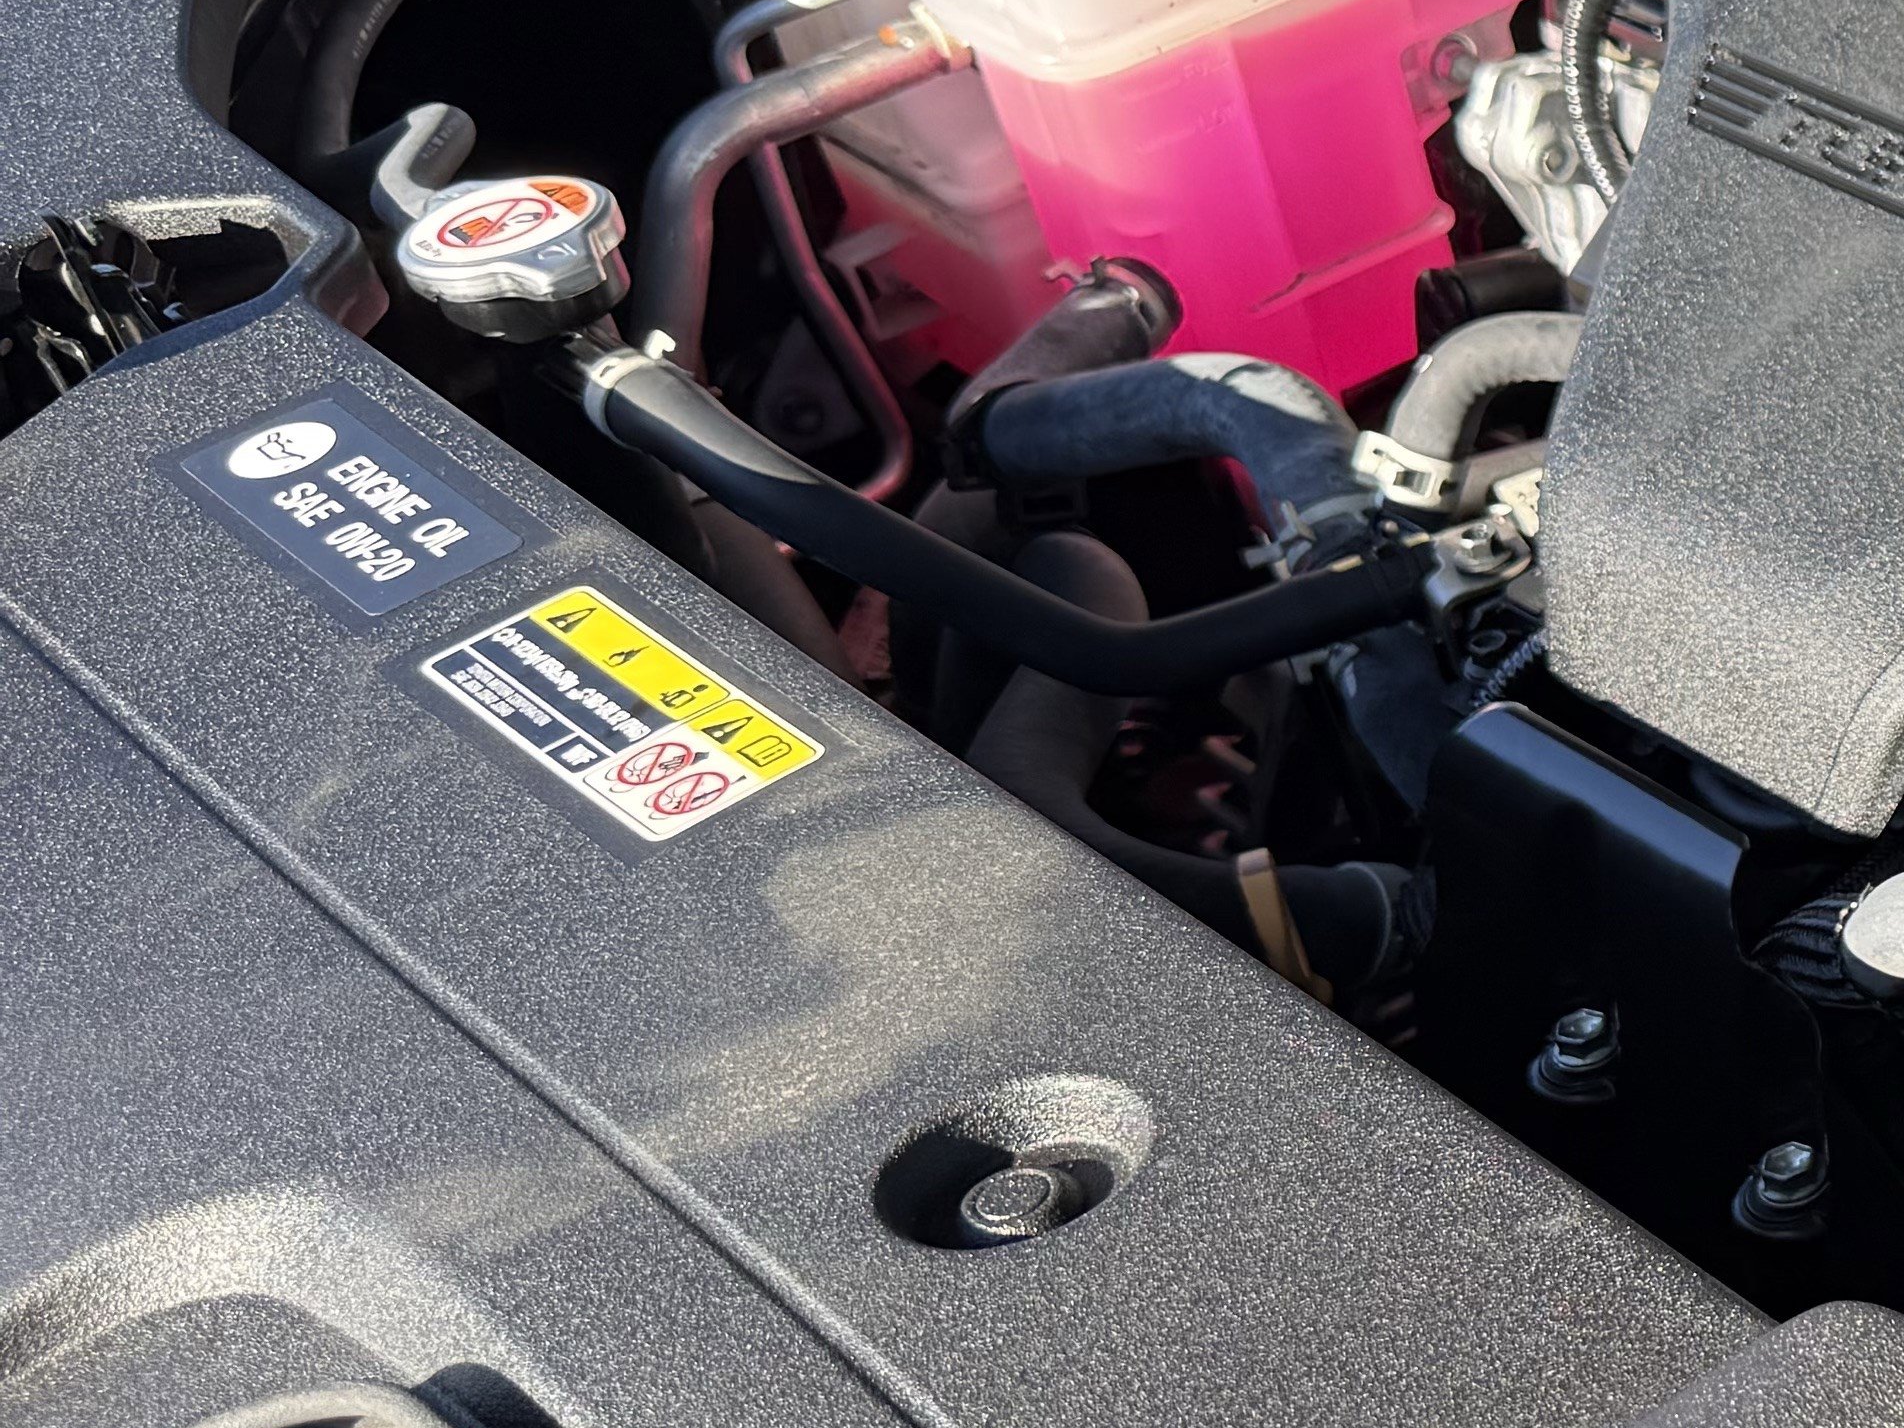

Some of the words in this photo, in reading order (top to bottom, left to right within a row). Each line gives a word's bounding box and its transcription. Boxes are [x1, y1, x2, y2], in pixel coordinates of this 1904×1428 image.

[271, 480, 346, 528] SAE
[324, 521, 416, 582] 0W-20
[327, 455, 432, 525] ENGINE
[411, 518, 470, 558] OIL
